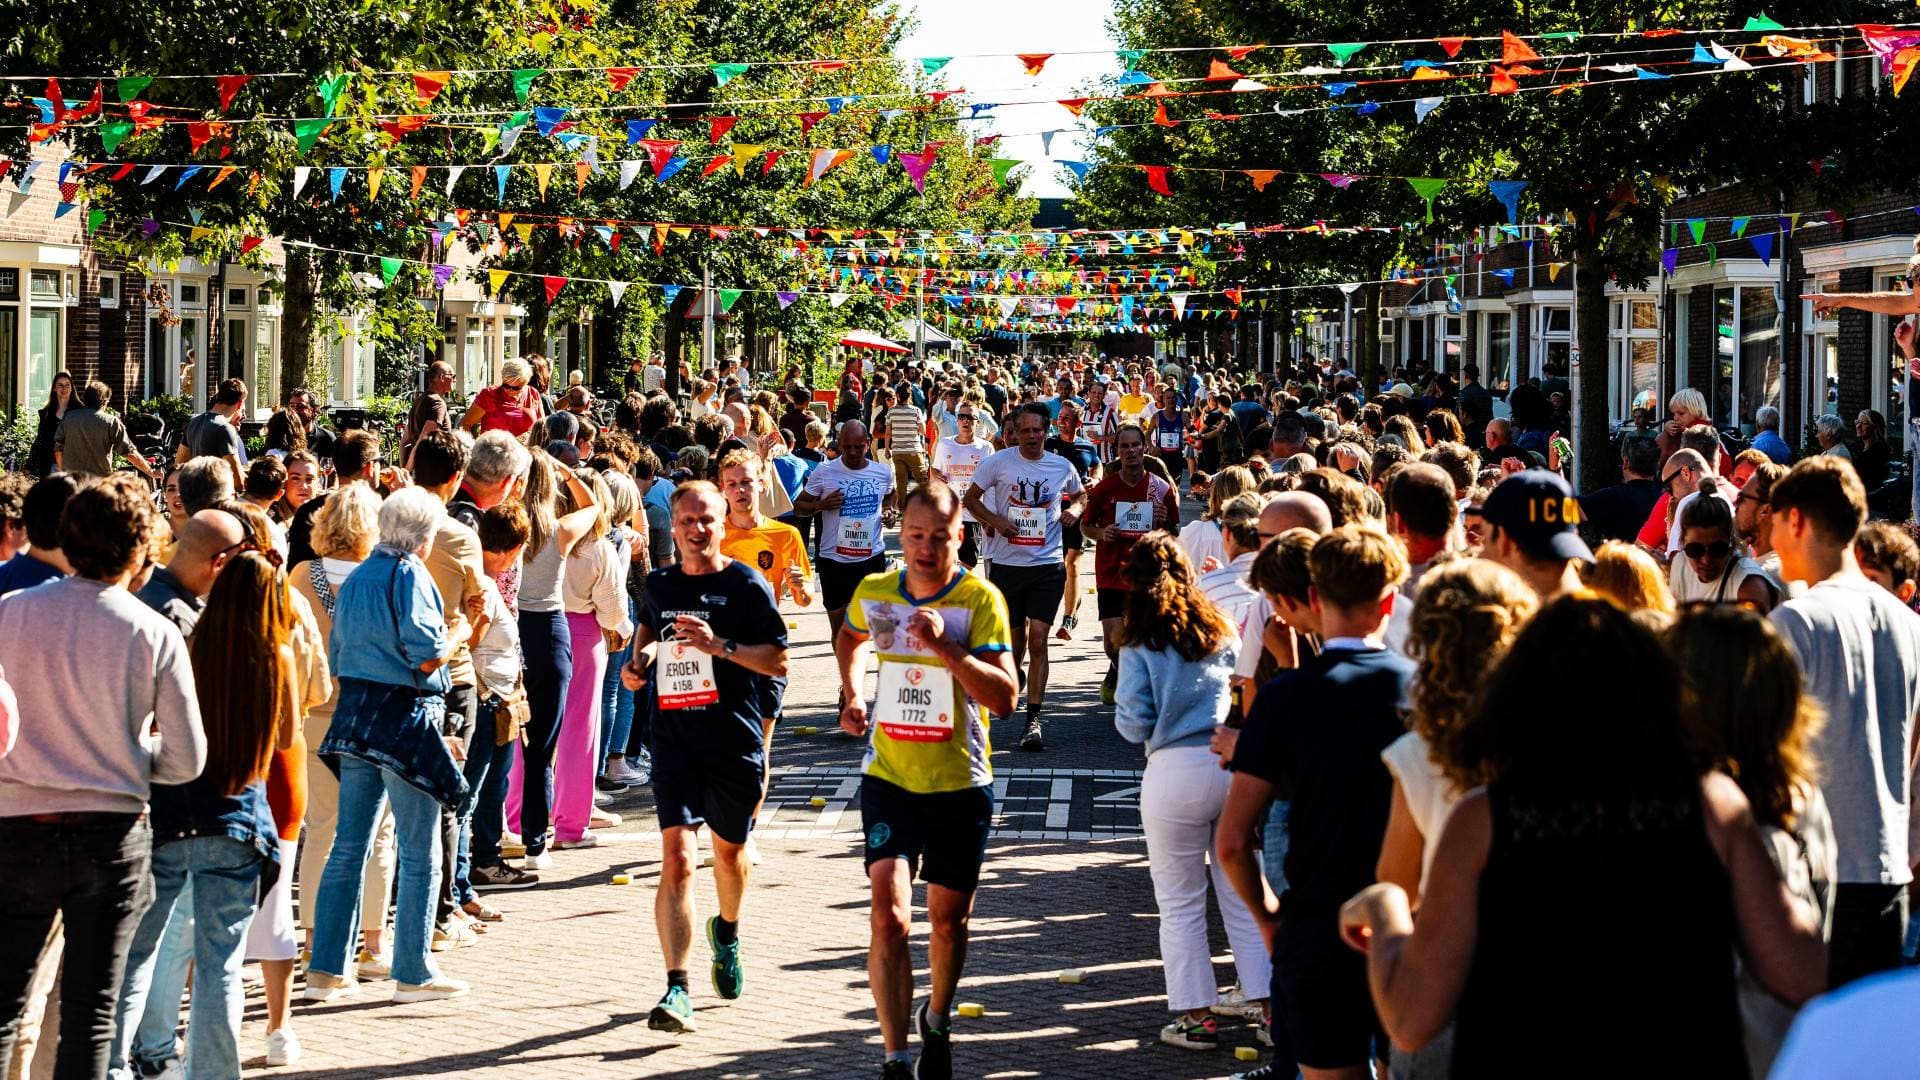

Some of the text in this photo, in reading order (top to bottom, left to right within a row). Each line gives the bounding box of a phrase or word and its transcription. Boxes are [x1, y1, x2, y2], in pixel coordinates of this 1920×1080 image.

[845, 496, 874, 505] SLIMMER
[1015, 518, 1038, 528] MAXIM
[845, 530, 869, 539] DIMITRI
[665, 660, 700, 677] JEROEN
[673, 680, 693, 692] 4158
[897, 687, 931, 706] JORIS
[902, 709, 926, 723] 1772
[893, 727, 914, 736] Tilburg
